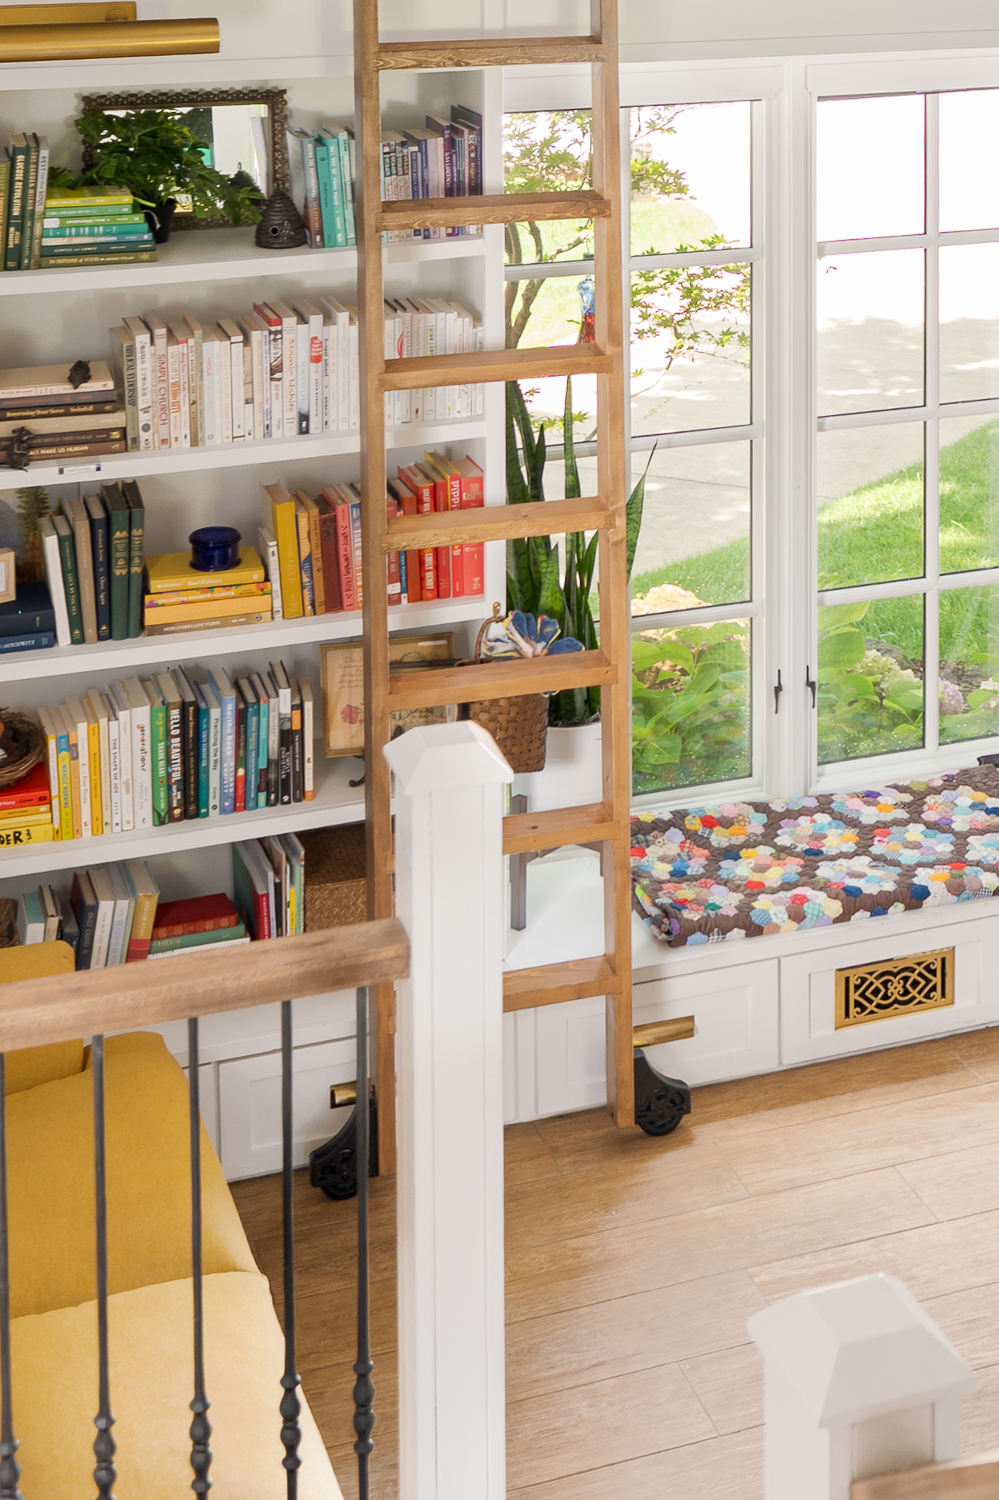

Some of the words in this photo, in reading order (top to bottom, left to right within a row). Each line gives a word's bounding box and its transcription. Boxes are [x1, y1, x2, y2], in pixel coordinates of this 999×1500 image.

[16, 155, 25, 181] GLUCOSE
[12, 182, 22, 216] REVOLUTION
[140, 341, 148, 364] Jesus
[286, 338, 295, 376] Atomic
[140, 367, 149, 397] Freaks
[159, 387, 167, 426] CHURCH
[285, 379, 295, 413] Habits
[422, 489, 431, 503] GREAT
[423, 503, 432, 512] BIG
[353, 528, 362, 548] TAKE
[424, 553, 433, 571] EMILY
[425, 572, 434, 590] HENRY
[169, 709, 180, 735] HELLO
[137, 724, 148, 771] generations
[170, 738, 181, 782] BEAUTIFUL
